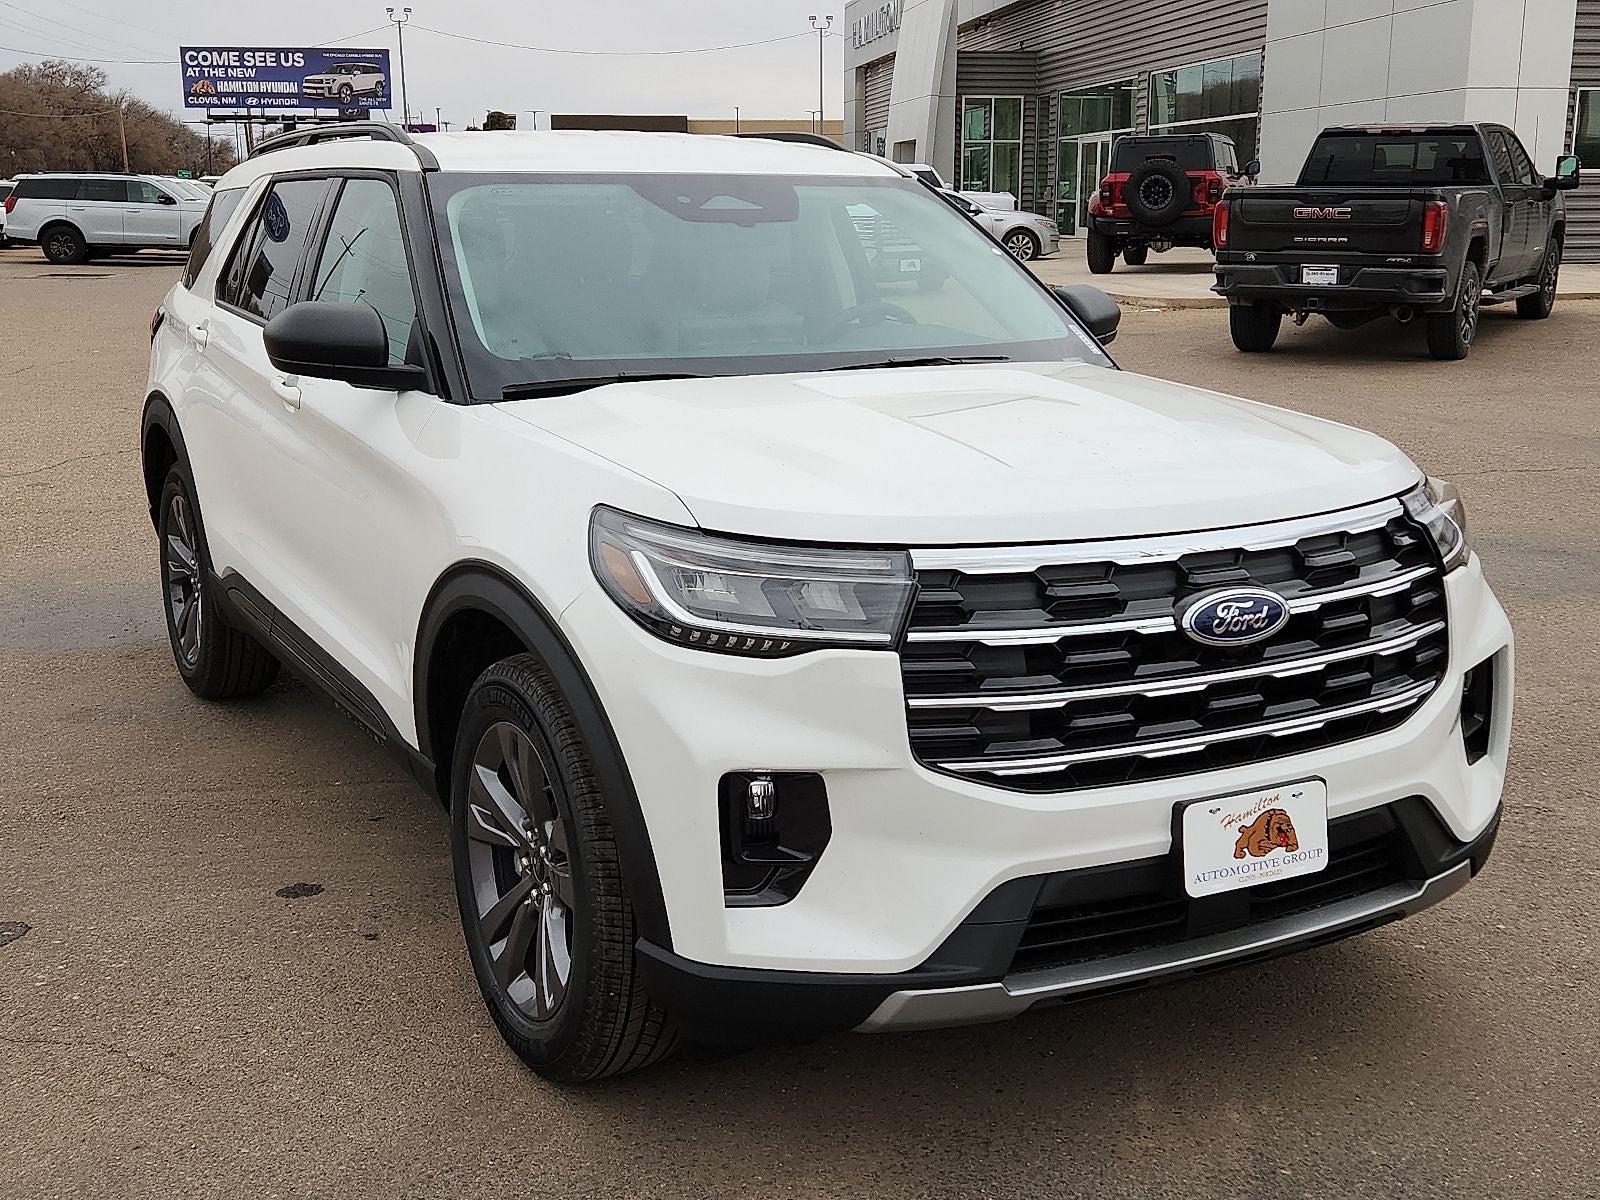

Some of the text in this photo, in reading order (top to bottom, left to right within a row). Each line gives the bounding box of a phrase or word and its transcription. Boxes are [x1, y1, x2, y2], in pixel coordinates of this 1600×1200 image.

[184, 50, 305, 67] COME SEE US
[185, 67, 256, 78] AT THE NEW
[216, 80, 298, 93] HAMILTON HYUNDAI
[188, 96, 237, 105] CLOVIS, NM
[260, 98, 299, 106] HYUNDAI
[1293, 207, 1352, 219] GMC
[1212, 600, 1269, 635] Ford
[1220, 793, 1281, 831] Hamilton
[1193, 848, 1323, 884] AUTOMOTIVE GROUP
